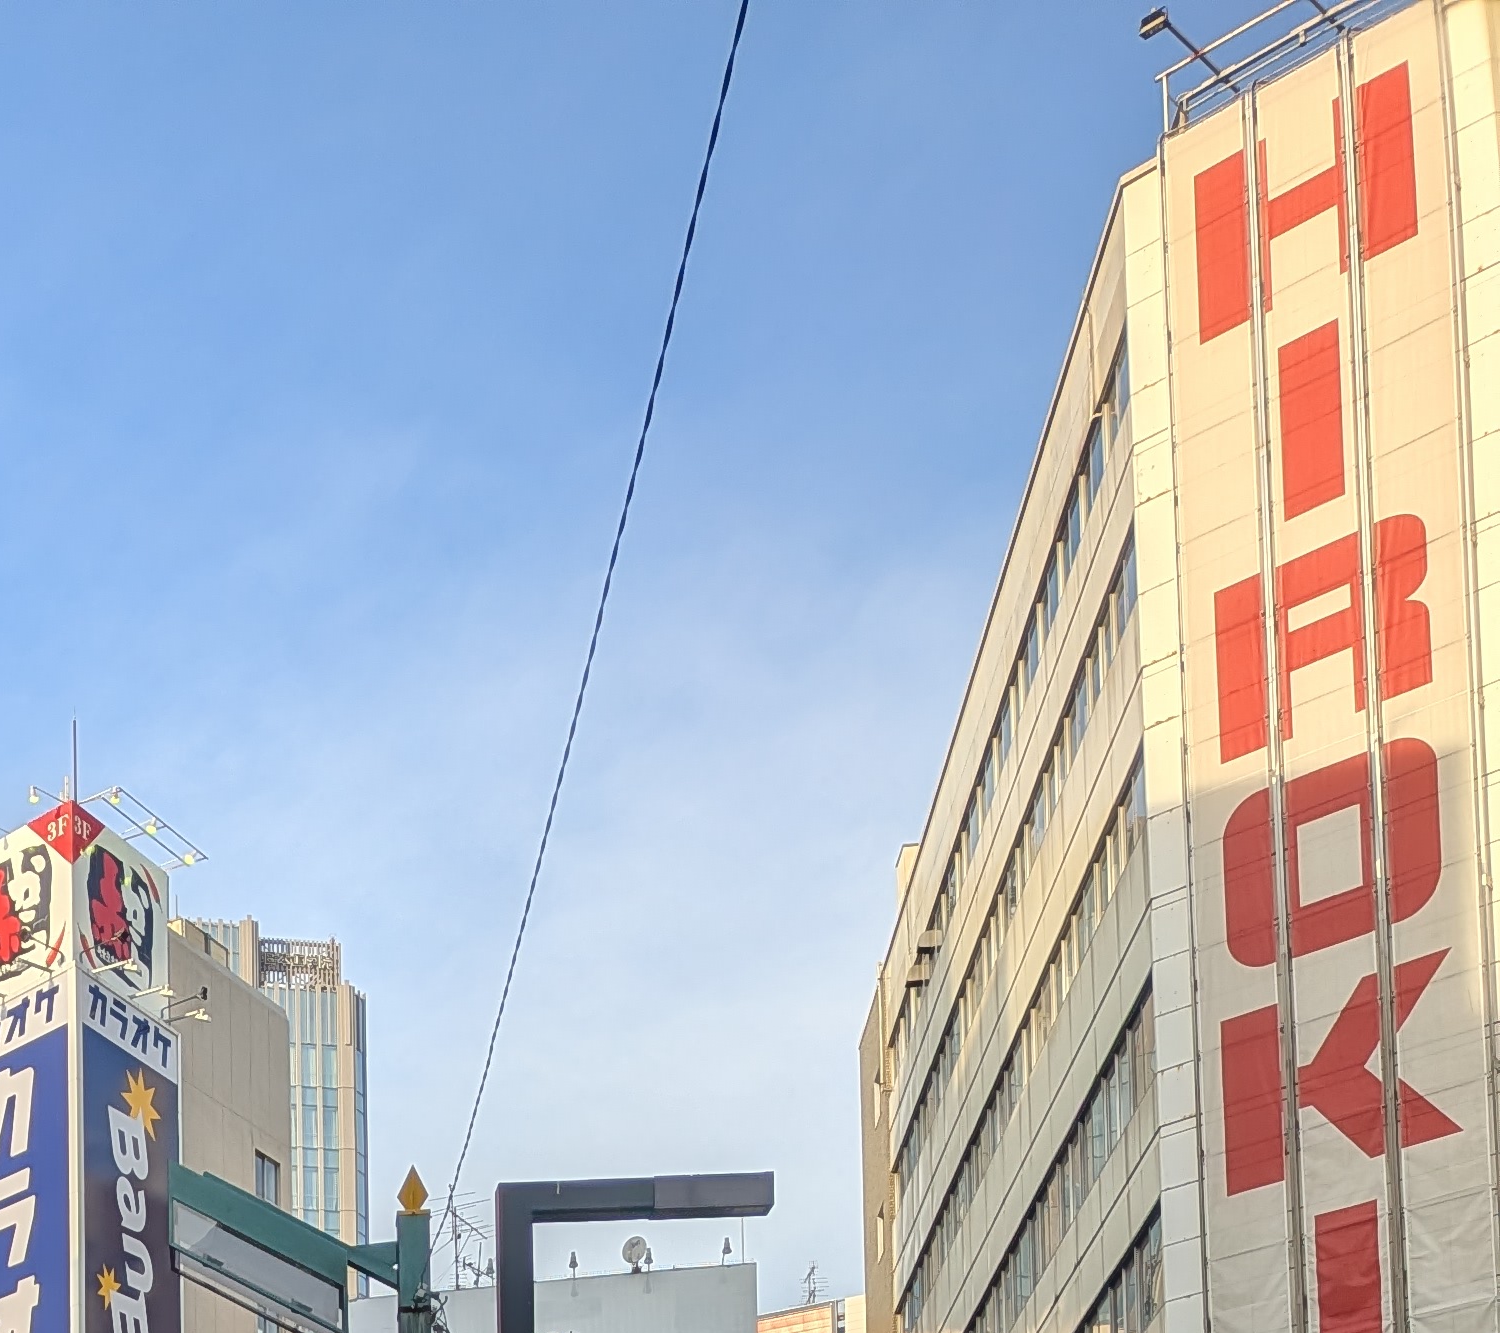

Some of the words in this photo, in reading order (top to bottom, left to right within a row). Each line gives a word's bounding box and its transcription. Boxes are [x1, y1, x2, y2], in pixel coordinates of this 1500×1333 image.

[47, 813, 70, 842] 3F
[74, 814, 93, 841] 3F
[88, 984, 172, 1069] カラオケ
